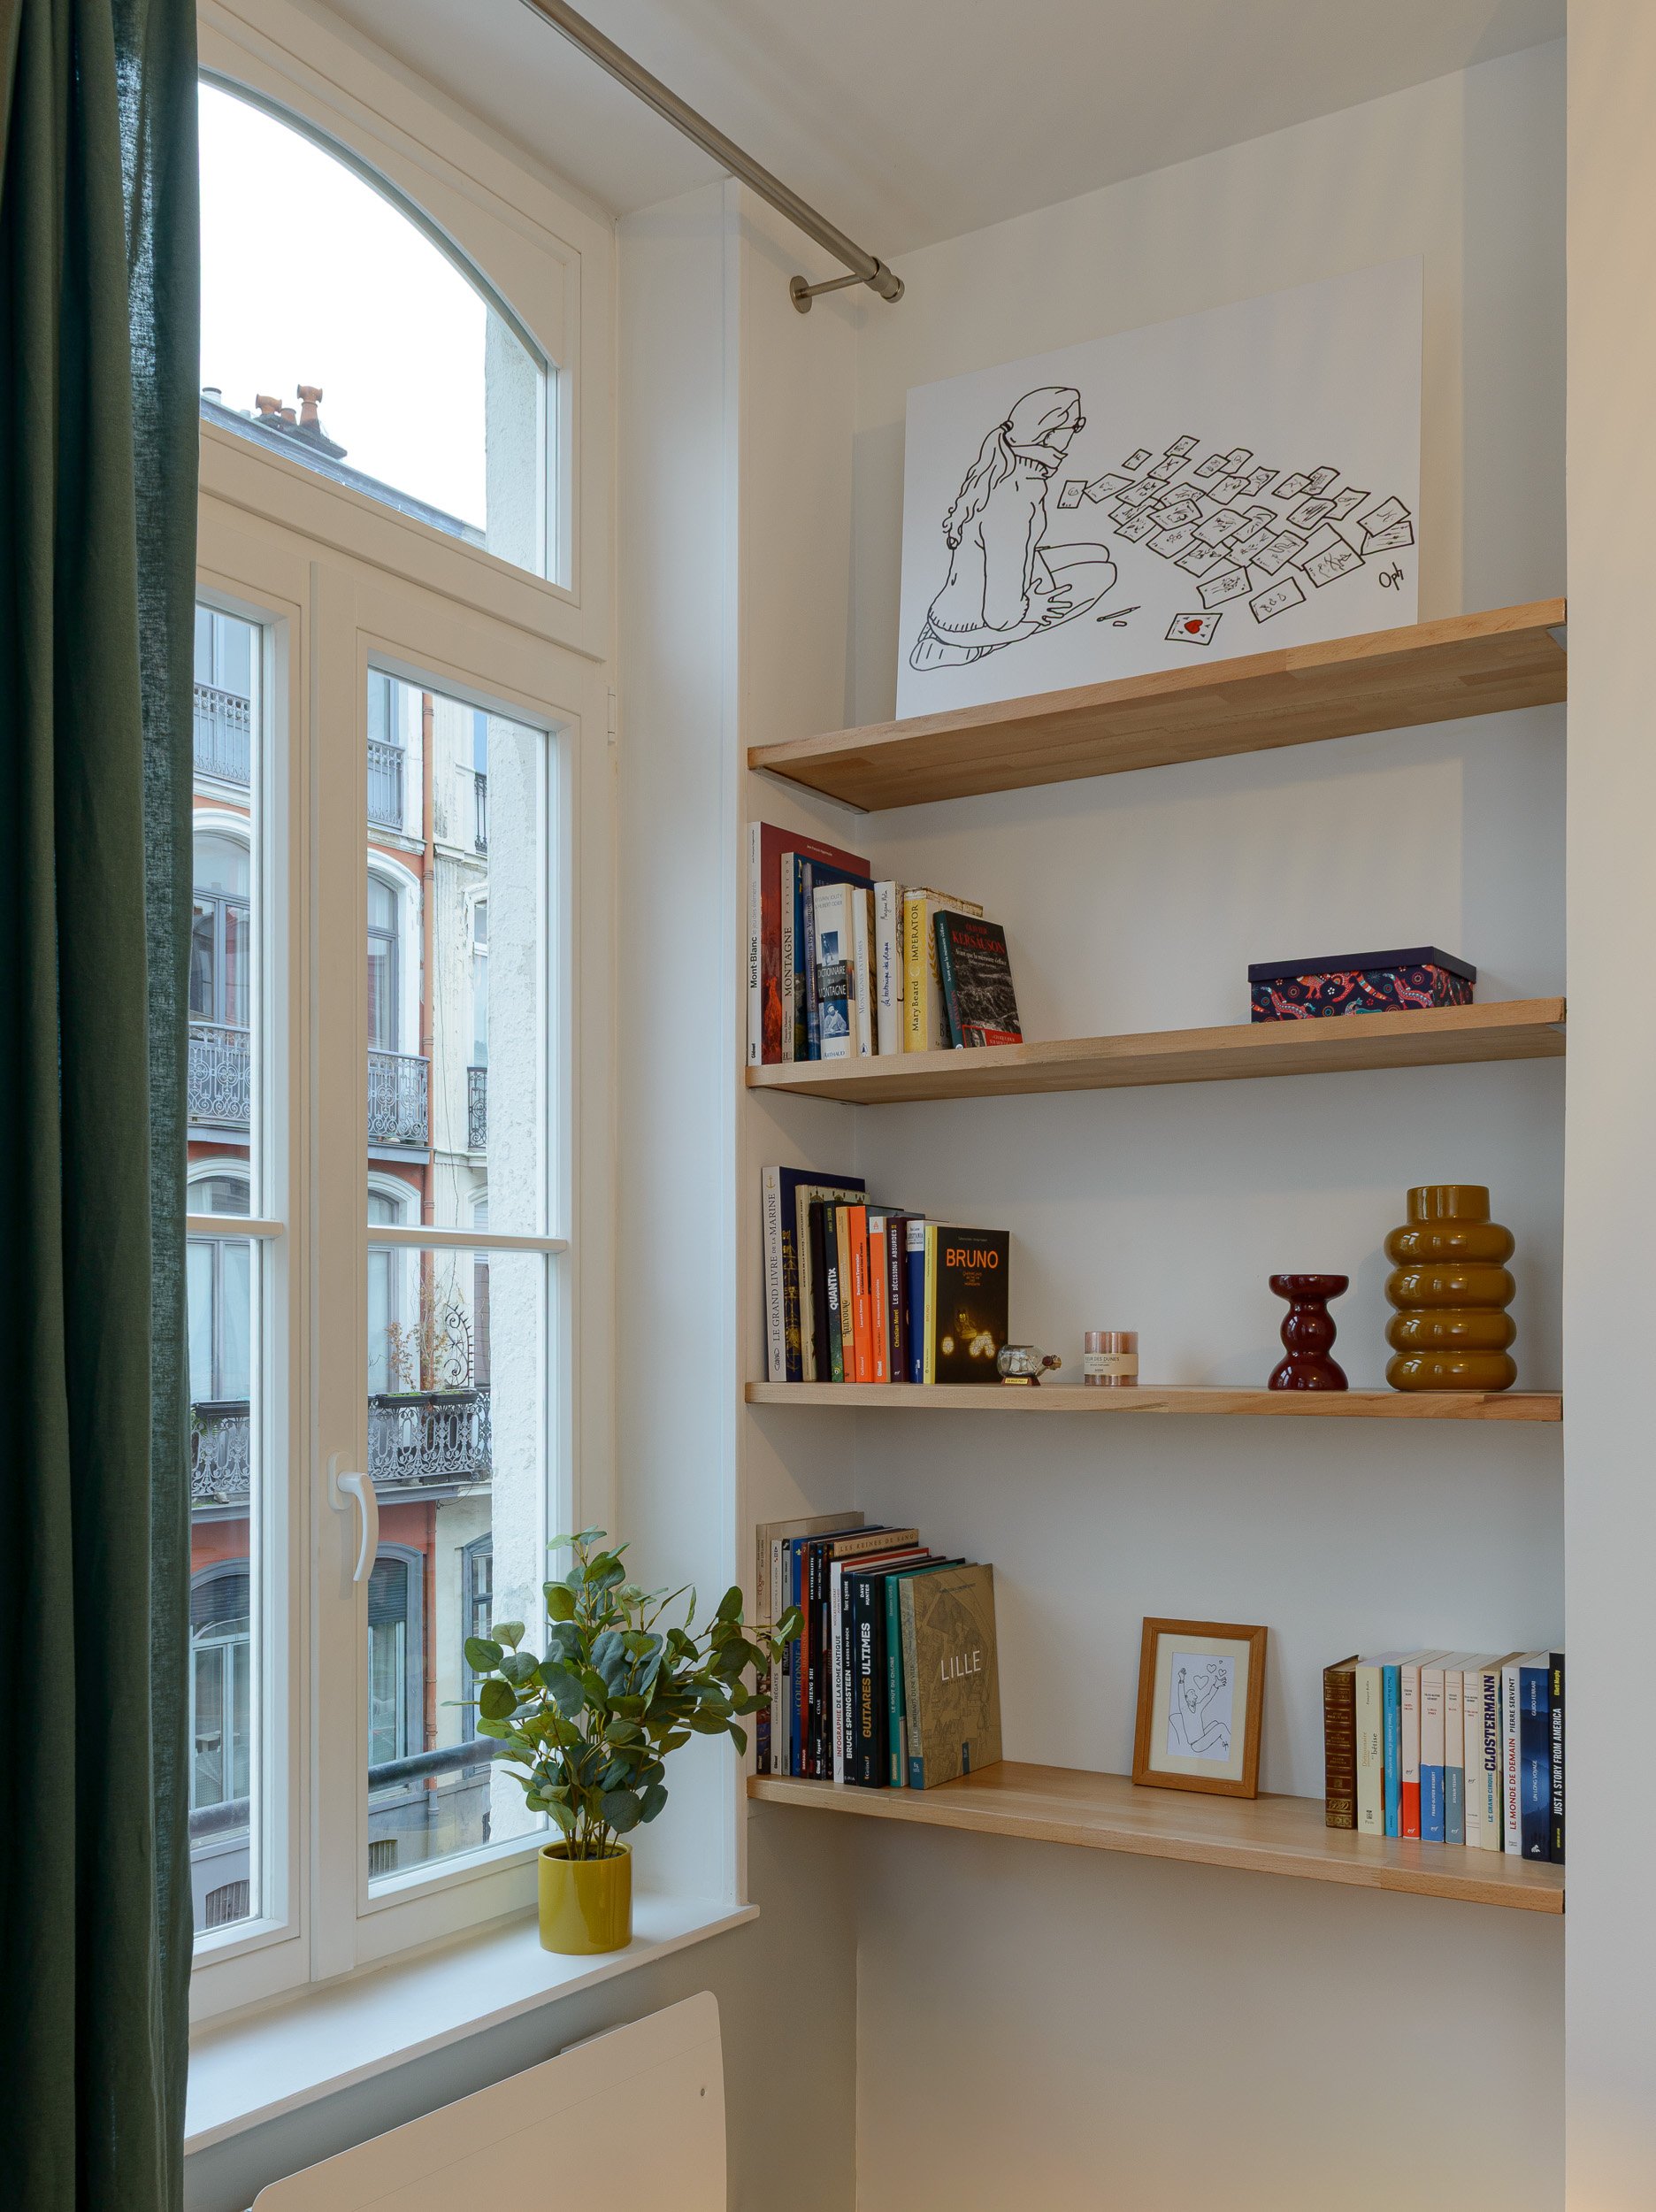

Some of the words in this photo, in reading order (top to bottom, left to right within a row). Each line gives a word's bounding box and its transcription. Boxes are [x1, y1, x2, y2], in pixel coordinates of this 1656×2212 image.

[1378, 562, 1404, 591] Oph
[910, 904, 919, 961] IMPERATOR
[784, 926, 793, 996] MONTAGNE
[817, 965, 846, 978] DICTIONNAIRE
[818, 984, 847, 998] MONTAGNE
[912, 1007, 921, 1032] Mary
[946, 1248, 999, 1269] BRUNO
[828, 1267, 839, 1310] QUANTIX
[773, 1329, 780, 1341] LE
[897, 1533, 914, 1542] SANG
[862, 1623, 871, 1675] ULTIMES
[940, 1650, 982, 1681] LILLE
[836, 1689, 841, 1698] LA
[836, 1700, 841, 1709] DE
[862, 1678, 871, 1739] GUITARES
[1484, 1674, 1496, 1771] CLOSTERMANN
[1552, 1708, 1562, 1741] AMERICA
[1552, 1742, 1562, 1763] FROM
[1508, 1773, 1516, 1785] DE
[1552, 1764, 1562, 1789] STORY
[1553, 1797, 1563, 1816] JUST
[1509, 1821, 1517, 1830] LE
